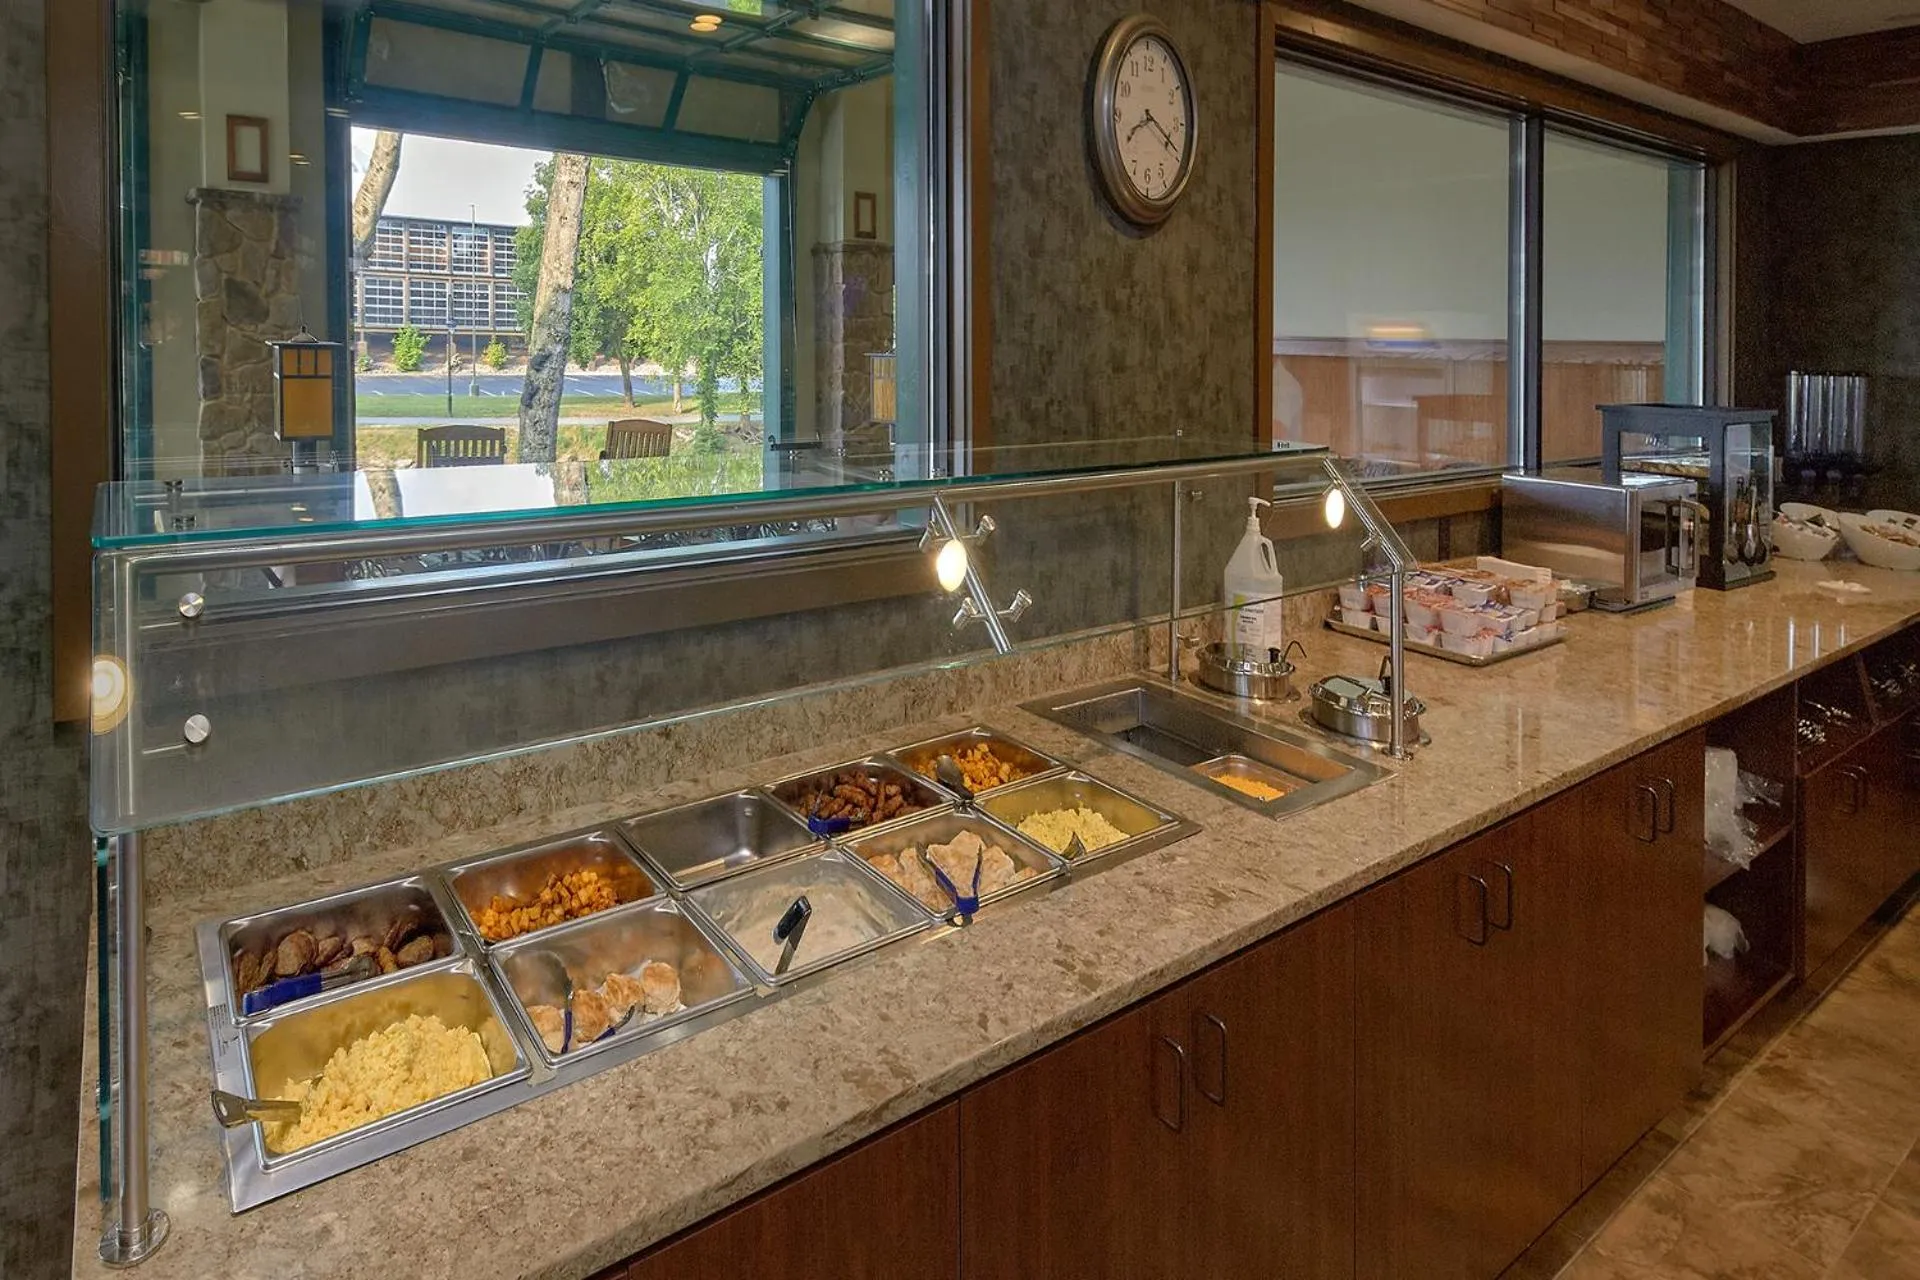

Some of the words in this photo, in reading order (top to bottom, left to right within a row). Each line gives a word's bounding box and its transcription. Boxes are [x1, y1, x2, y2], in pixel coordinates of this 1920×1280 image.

[1130, 60, 1139, 77] 11
[1143, 56, 1154, 72] 12
[1160, 67, 1165, 84] 1
[1120, 81, 1131, 98] 10
[1168, 89, 1175, 105] 2
[1113, 109, 1121, 124] 9
[1173, 117, 1179, 133] 3
[1131, 159, 1138, 176] 7
[1143, 167, 1151, 184] 6
[1158, 162, 1164, 179] 5
